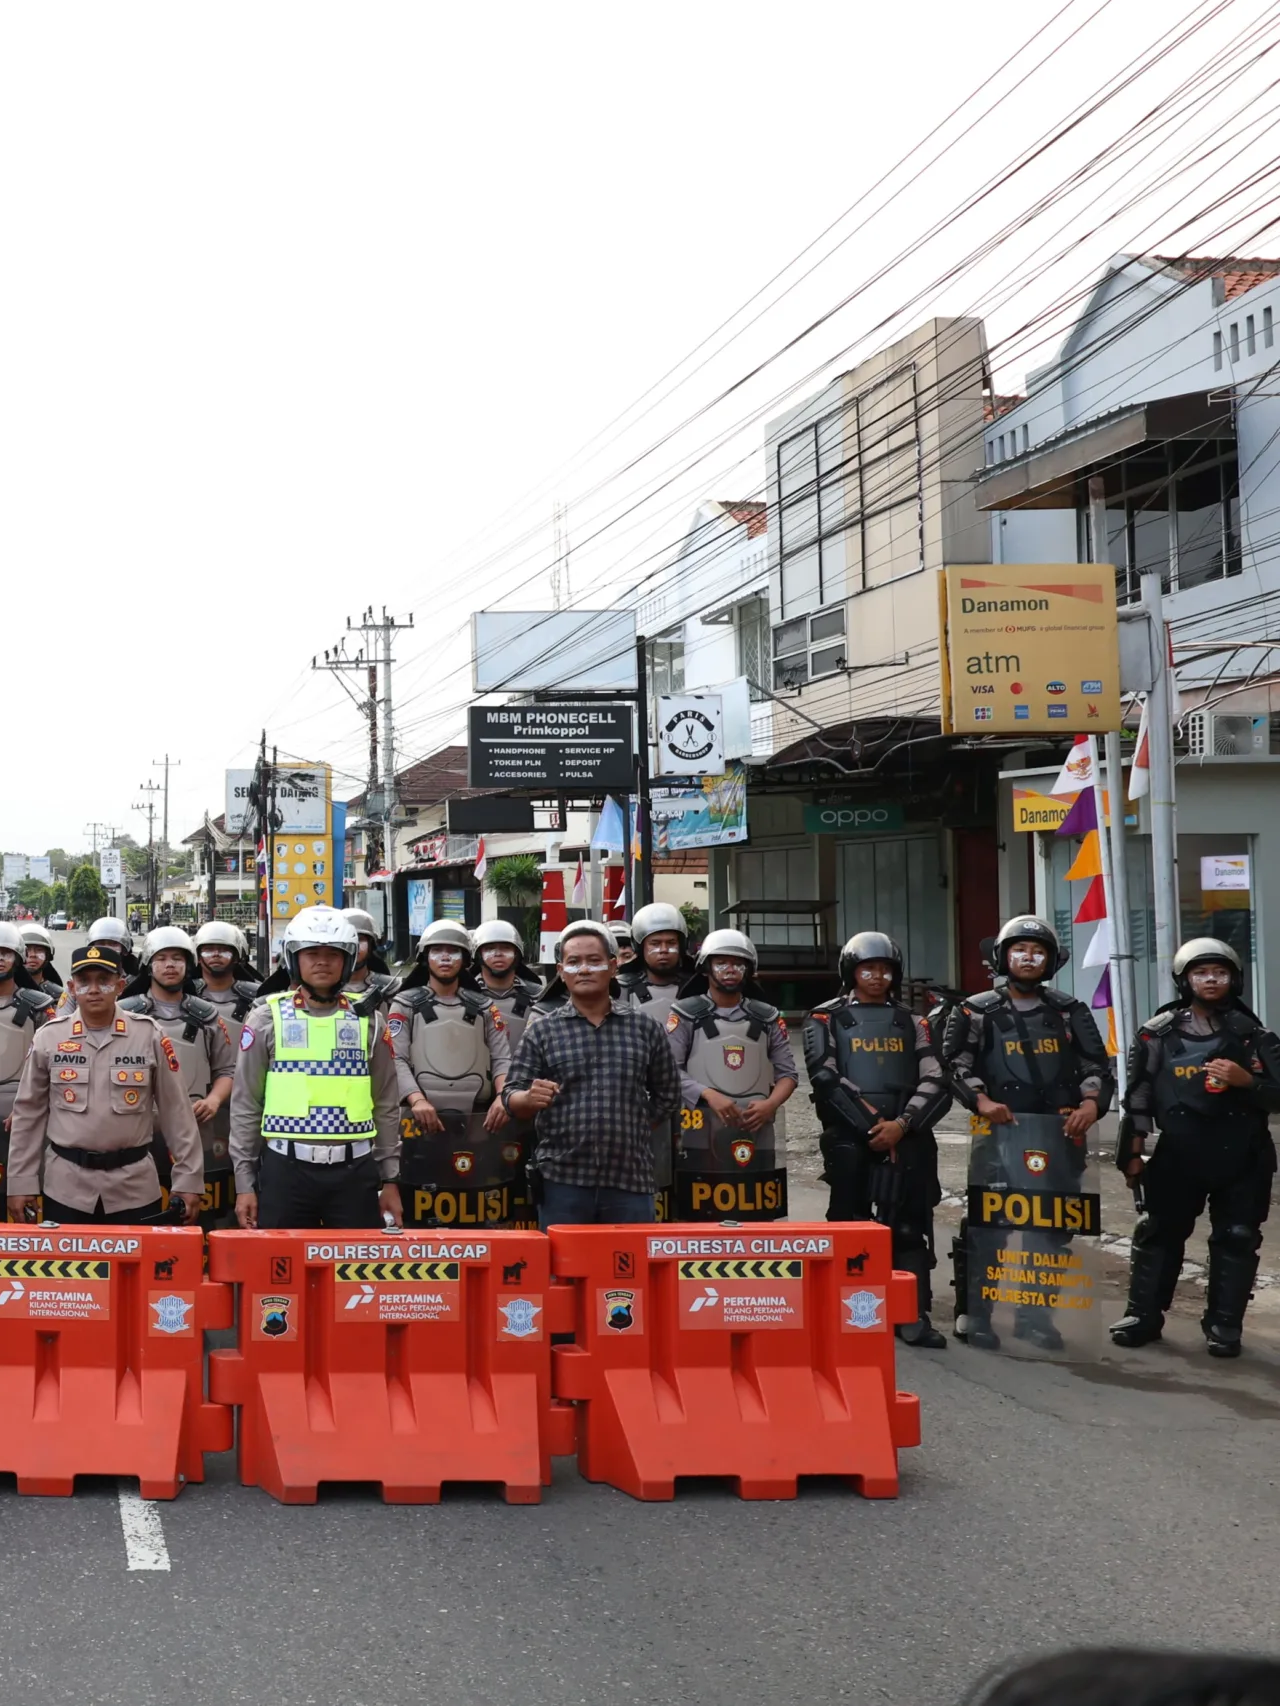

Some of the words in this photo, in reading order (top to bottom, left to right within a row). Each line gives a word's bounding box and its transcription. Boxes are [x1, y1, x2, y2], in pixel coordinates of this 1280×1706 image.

[961, 598, 1049, 614] Danamon
[966, 651, 1020, 675] atm
[971, 685, 995, 694] VISA
[487, 712, 522, 723] MBM
[526, 712, 616, 724] PHONECELL
[673, 711, 705, 723] PARIS
[513, 725, 589, 737] Primkoppol
[675, 747, 708, 758] BARBERSHOP
[820, 809, 888, 827] oppo
[1215, 867, 1245, 876] Danamon
[851, 1037, 904, 1053] POLISI
[53, 1054, 87, 1065] DAVID
[115, 1055, 146, 1065] POLRI
[333, 1050, 364, 1061] POLISI
[680, 1109, 704, 1130] 38
[969, 1115, 992, 1136] 52
[692, 1181, 782, 1211] POLISI
[415, 1187, 508, 1224] POLISI
[982, 1191, 1091, 1230] POLISI
[58, 1238, 139, 1254] CILACAP
[307, 1244, 403, 1260] POLRESTA
[408, 1244, 487, 1260] CILACAP
[650, 1239, 746, 1255] POLRESTA
[751, 1239, 831, 1254] CILACAP
[997, 1249, 1029, 1266] UNIT
[987, 1266, 1036, 1285] SATUAN
[29, 1291, 93, 1302] PERTAMINA
[379, 1294, 443, 1304] PERTAMINA
[723, 1296, 787, 1307] PERTAMINA
[982, 1286, 1046, 1307] POLRESTA
[29, 1302, 58, 1310] KILANG
[59, 1302, 101, 1310] PERTAMINA
[379, 1304, 408, 1312] KILANG
[409, 1304, 451, 1312] PERTAMINA
[723, 1306, 752, 1315] KILANG
[753, 1306, 795, 1315] PERTAMINA
[29, 1309, 90, 1317] INTERNASIONAL
[379, 1312, 440, 1320] INTERNASIONAL
[723, 1314, 783, 1323] INTERNASIONAL
